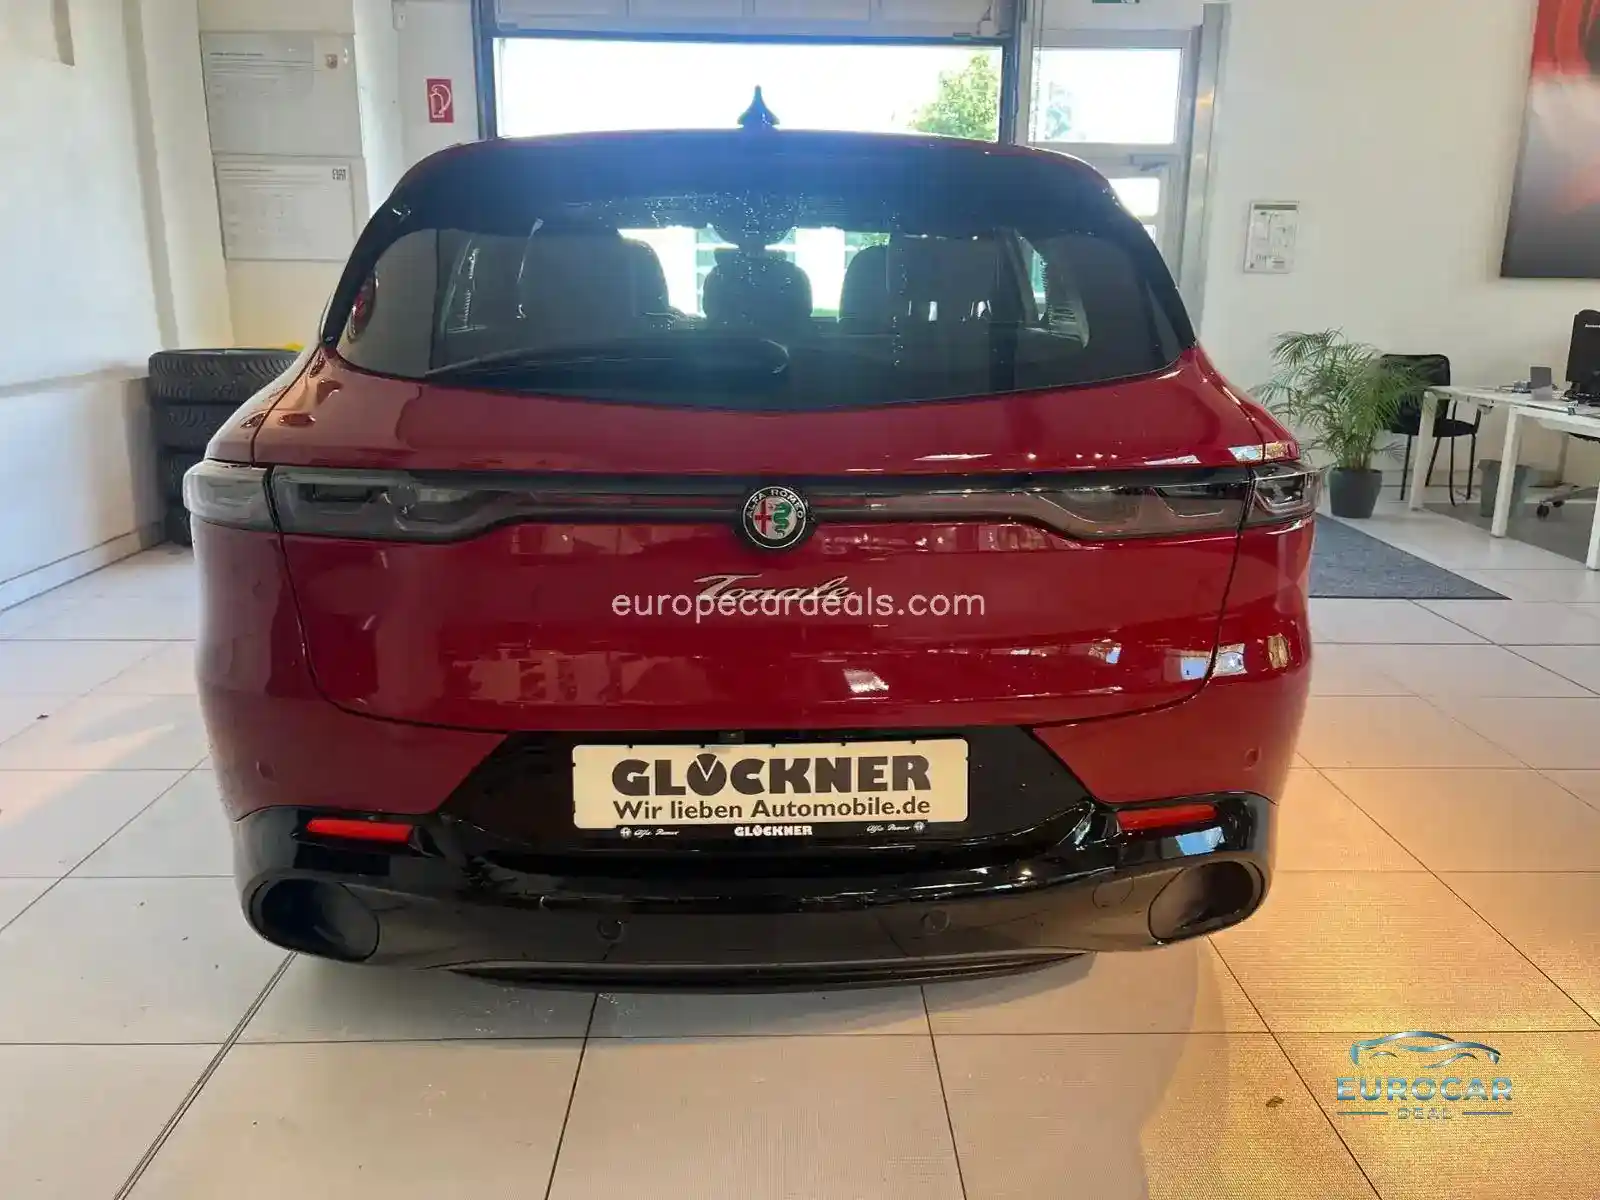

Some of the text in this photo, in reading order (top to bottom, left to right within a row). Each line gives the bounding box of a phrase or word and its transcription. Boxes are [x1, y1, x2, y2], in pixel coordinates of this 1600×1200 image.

[746, 489, 804, 519] ALFA ROMEO
[613, 795, 931, 820] Wir lieben Automobile.de
